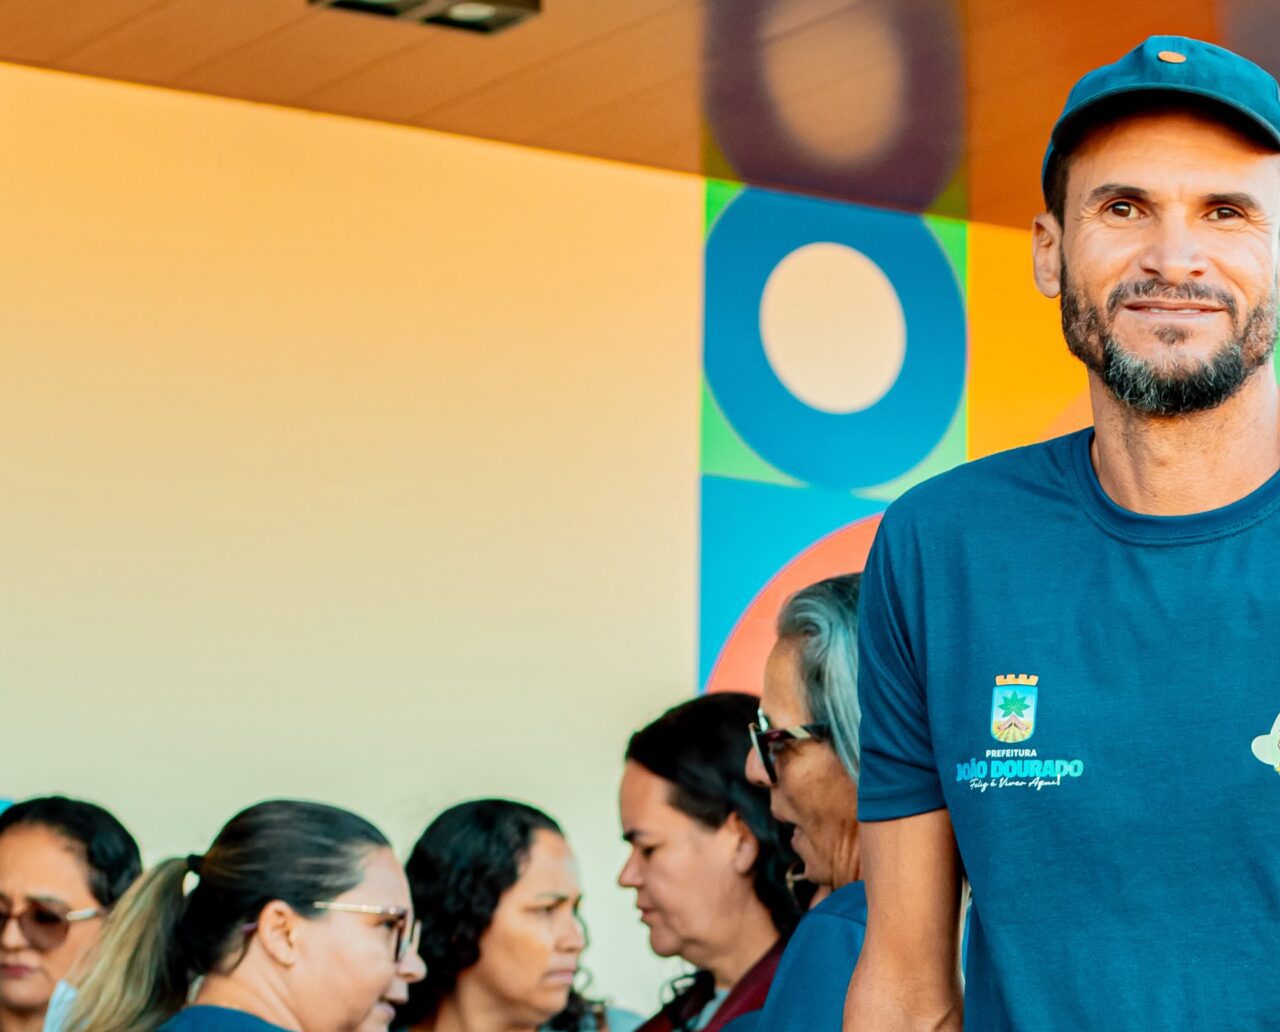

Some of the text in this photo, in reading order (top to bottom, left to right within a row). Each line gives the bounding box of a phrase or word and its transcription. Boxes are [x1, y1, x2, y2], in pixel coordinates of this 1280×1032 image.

[985, 749, 1037, 758] PREFEITURA
[956, 758, 1084, 782] JOÃO DOURADO
